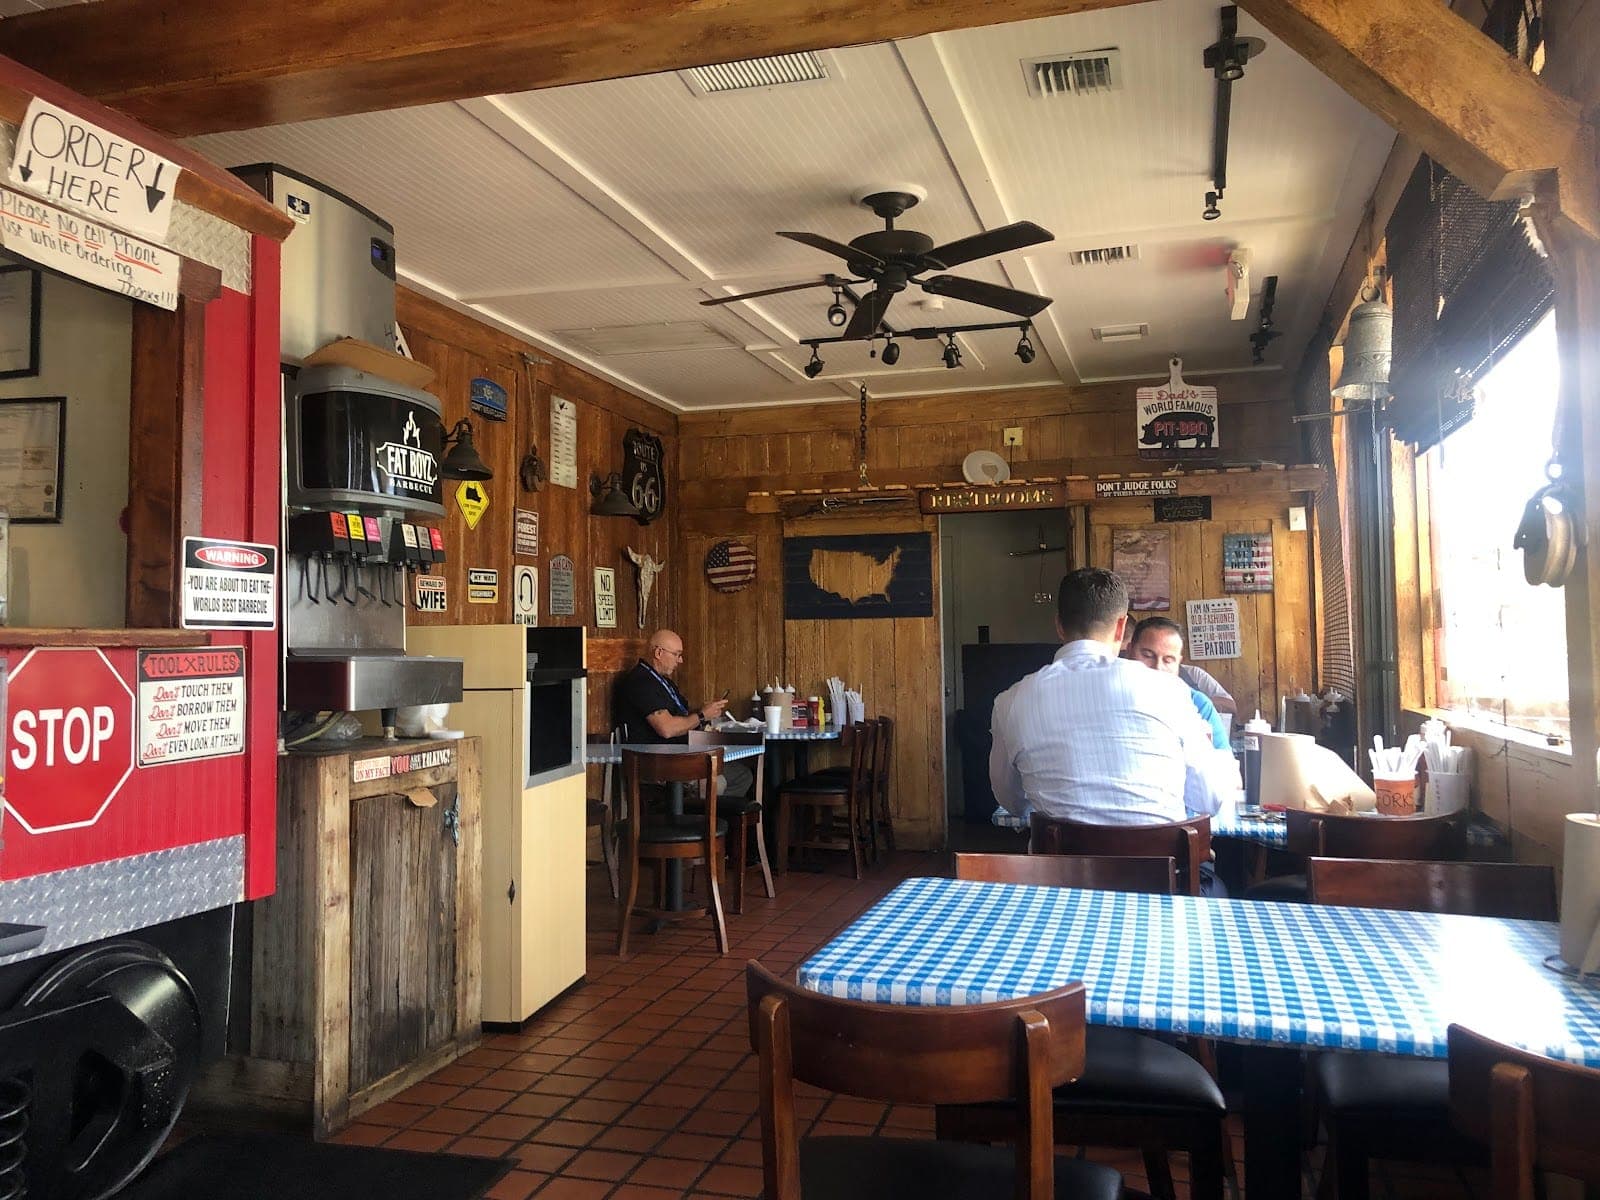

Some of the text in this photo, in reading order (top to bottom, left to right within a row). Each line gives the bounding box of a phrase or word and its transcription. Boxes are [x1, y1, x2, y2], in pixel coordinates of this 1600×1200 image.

[31, 112, 146, 189] ORDER
[47, 166, 121, 213] HERE
[1156, 389, 1200, 400] Dad's
[1143, 400, 1214, 416] WORLD FAMOUS
[387, 446, 434, 481] FAT BOYZ
[389, 477, 433, 495] BARBECUE
[632, 472, 658, 514] 66
[1096, 479, 1178, 492] DON'T JUDGE FOLKS
[930, 489, 1054, 508] RESTROOMS
[1238, 539, 1259, 548] THIS
[205, 549, 259, 565] WARNING
[1230, 561, 1267, 569] DEFEND
[190, 575, 270, 594] YOU ARE ABOUT TO EAT THE
[600, 574, 611, 592] NO
[193, 596, 268, 614] WORLDS BEST BARBECUE
[419, 590, 446, 609] WIFE
[1193, 603, 1202, 614] AM
[1202, 603, 1210, 613] AN
[1204, 640, 1237, 656] PATRIOT
[149, 655, 236, 675] TOOL RULES
[182, 684, 209, 698] TOUCH
[211, 682, 233, 695] THEM
[177, 702, 214, 716] BORROW
[216, 699, 237, 712] THEM
[184, 720, 207, 734] MOVE
[210, 717, 231, 730] THEM
[11, 706, 115, 770] STOP
[169, 739, 188, 754] EVEN
[190, 736, 208, 751] LOOK
[211, 735, 220, 748] AT
[391, 754, 410, 775] YOU
[1376, 788, 1414, 808] FORKS
